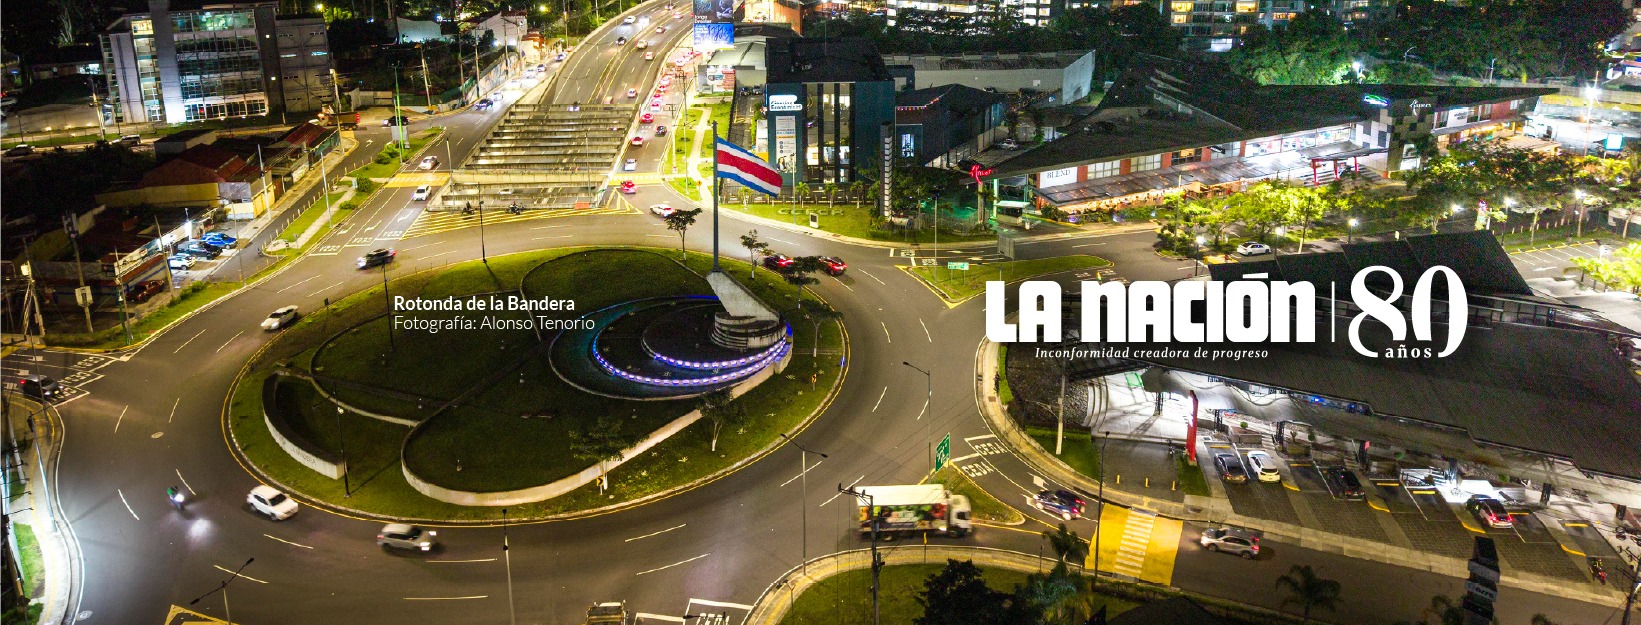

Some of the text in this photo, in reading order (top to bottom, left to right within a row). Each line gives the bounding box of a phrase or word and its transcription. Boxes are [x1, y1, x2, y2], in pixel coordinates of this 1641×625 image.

[1046, 169, 1071, 179] BLEND
[974, 442, 1007, 456] CEDA
[961, 461, 994, 478] CEDA
